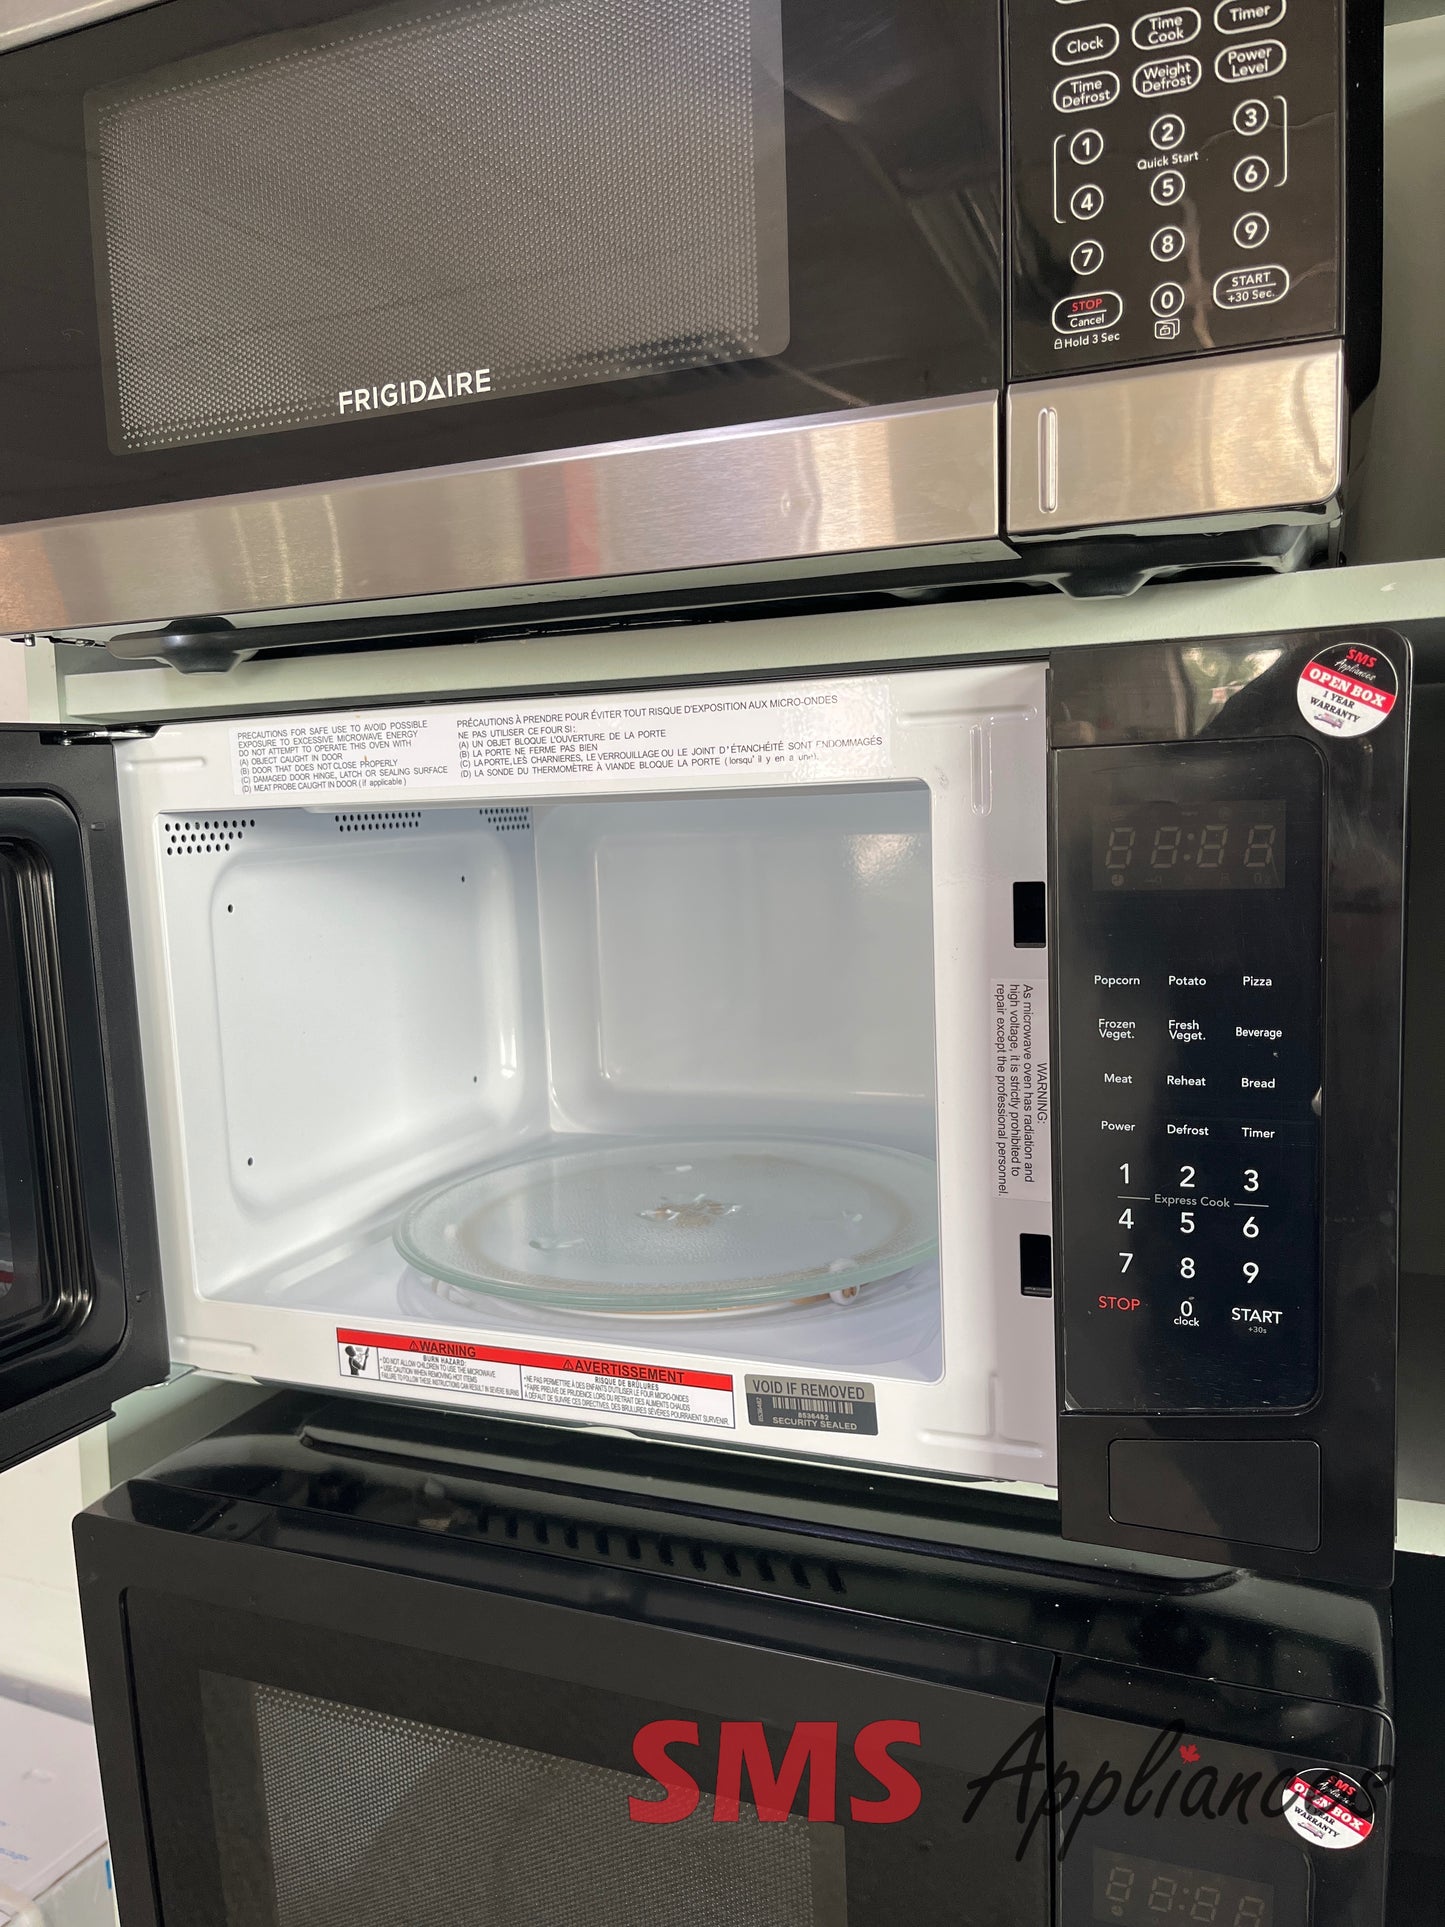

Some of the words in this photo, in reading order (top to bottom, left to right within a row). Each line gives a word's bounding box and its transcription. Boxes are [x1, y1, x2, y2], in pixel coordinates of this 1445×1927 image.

[1230, 4, 1270, 21] Timer
[1149, 15, 1182, 29] Time
[1148, 27, 1184, 45] Cook
[1067, 37, 1104, 53] Clock
[1228, 47, 1272, 65] Power
[1144, 62, 1191, 81] Weight
[1232, 59, 1268, 77] Level
[1071, 79, 1102, 93] Time
[1143, 74, 1192, 92] Defrost
[1063, 90, 1110, 108] Defrost
[1245, 109, 1257, 126] 3
[1162, 124, 1174, 140] 2
[1081, 138, 1090, 155] 1
[1137, 155, 1169, 170] Quick
[1173, 151, 1199, 165] Start
[1245, 165, 1257, 183] 6
[1163, 179, 1174, 196] 5
[1081, 194, 1093, 211] 4
[1245, 222, 1257, 240] 9
[1162, 236, 1174, 253] 8
[1081, 250, 1092, 267] 7
[1232, 272, 1271, 286] START
[1162, 292, 1173, 309] 0
[1228, 291, 1249, 303] +30
[1252, 288, 1275, 301] Sec.
[1072, 299, 1103, 312] STOP
[1070, 314, 1104, 328] Cancel
[1065, 336, 1089, 348] Hold
[1092, 334, 1098, 344] 3
[1101, 331, 1120, 343] Sec
[339, 369, 491, 414] FRIGIDAIRE
[1346, 648, 1377, 668] SMS
[1334, 659, 1376, 680] Appliances
[1309, 668, 1351, 693] OPEN
[1350, 682, 1386, 707] BOX
[1310, 697, 1360, 722] WARRANTY
[1331, 694, 1355, 709] YEAR
[457, 717, 514, 728] PRÉCAUTIONS
[516, 714, 521, 724] À
[523, 714, 562, 724] PRENDRE
[565, 712, 589, 720] POUR
[591, 709, 621, 719] ÉVITER
[624, 709, 646, 717] TOUT
[649, 705, 682, 716] RISQUE
[684, 702, 746, 713] D'EXPOSITION
[749, 700, 767, 709] AUX
[770, 695, 838, 707] MICRO-ONDES
[238, 730, 287, 740] PRECAUTIONS
[291, 728, 306, 736] FOR
[310, 727, 328, 735] SAFE
[332, 726, 346, 734] USE
[364, 723, 386, 731] AVOID
[390, 720, 428, 729] POSSIBLE
[238, 739, 276, 748] EXPOSURE
[294, 736, 333, 745] EXCESSIVE
[337, 732, 382, 742] MICROWAVE
[387, 730, 418, 739] ENERGY
[269, 747, 299, 755] ATTEMPT
[315, 744, 347, 752] OPERATE
[369, 741, 389, 749] OVEN
[252, 757, 276, 765] OBJECT
[280, 755, 308, 763] CAUGHT
[254, 775, 286, 783] DAMAGED
[290, 773, 310, 781] DOOR
[314, 772, 337, 780] HINGE,
[340, 770, 362, 778] LATCH
[380, 768, 410, 776] SEALING
[414, 766, 448, 774] SURFACE
[1094, 975, 1140, 988] Popcorn
[1168, 976, 1206, 986] Potato
[1243, 977, 1272, 986] Pizza
[994, 984, 1006, 1014] repair
[1008, 984, 1020, 1006] high
[1023, 984, 1034, 999] As
[1008, 1010, 1020, 1052] voltage,
[1024, 1002, 1033, 1059] microwave
[1099, 1019, 1135, 1028] Frozen
[1169, 1020, 1199, 1029] Fresh
[995, 1018, 1006, 1053] except
[1099, 1029, 1134, 1040] Veget.
[1169, 1030, 1205, 1042] Veget.
[1236, 1027, 1282, 1040] Beverage
[997, 1056, 1007, 1072] the
[1010, 1064, 1020, 1072] is
[1104, 1074, 1132, 1083] Meat
[1167, 1076, 1206, 1086] Reheat
[1242, 1078, 1275, 1088] Bread
[1008, 1076, 1020, 1108] strictly
[1037, 1063, 1048, 1124] WARNING:
[995, 1075, 1007, 1138] professional
[1024, 1092, 1034, 1111] has
[1101, 1121, 1135, 1131] Power
[1167, 1125, 1209, 1135] Defrost
[1242, 1128, 1275, 1138] Timer
[1008, 1112, 1021, 1163] prohibited
[1024, 1115, 1034, 1159] radiation
[996, 1142, 1008, 1196] personnel.
[1011, 1166, 1021, 1176] to
[1024, 1162, 1034, 1182] and
[1120, 1163, 1129, 1184] 1
[1180, 1166, 1195, 1187] 2
[1244, 1170, 1259, 1191] 3
[1155, 1194, 1197, 1207] Express
[1201, 1197, 1230, 1208] Cook
[1118, 1209, 1134, 1229] 4
[1180, 1212, 1195, 1233] 5
[1243, 1217, 1259, 1238] 6
[1119, 1253, 1133, 1273] 7
[1180, 1258, 1195, 1278] 8
[1243, 1262, 1259, 1283] 9
[1099, 1296, 1140, 1310] STOP
[1181, 1301, 1192, 1316] 0
[1174, 1317, 1199, 1327] clock
[1232, 1308, 1282, 1324] START
[1249, 1326, 1267, 1334] +30s
[420, 1341, 475, 1357] WARNING
[576, 1360, 684, 1383] AVERTISSEMENT
[753, 1379, 782, 1393] VOID
[787, 1382, 797, 1395] IF
[801, 1384, 865, 1400] REMOVED
[773, 1416, 817, 1427] SECURITY
[821, 1421, 857, 1430] SEALED
[1328, 1775, 1356, 1795] SMS
[1294, 1806, 1340, 1838] WARRANTY
[1330, 1806, 1364, 1830] BOX
